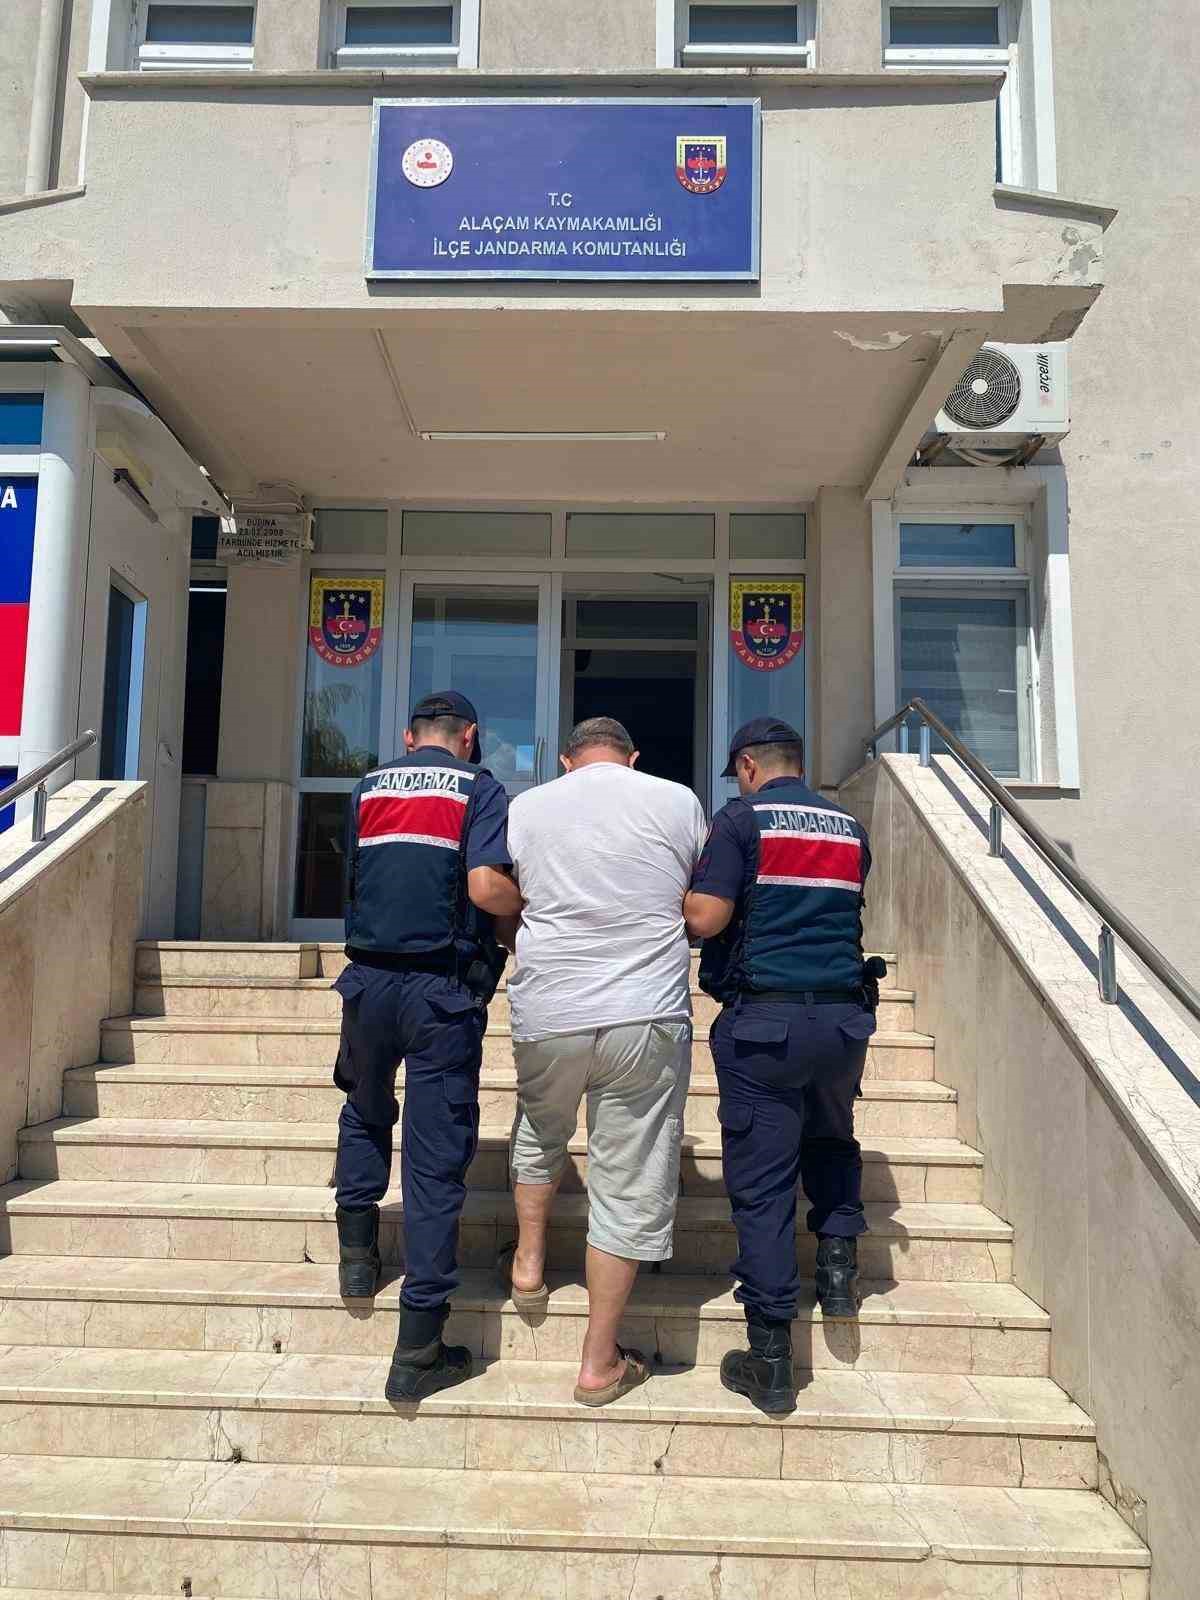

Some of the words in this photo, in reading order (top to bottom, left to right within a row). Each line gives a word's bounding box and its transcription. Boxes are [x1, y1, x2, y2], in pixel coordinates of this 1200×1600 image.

[548, 192, 573, 207] T.C
[459, 216, 529, 233] ALAÇAM
[534, 212, 662, 232] KAYMAKAMLIĞI
[433, 238, 470, 258] İLÇE
[475, 241, 568, 256] JANDARMA
[572, 239, 687, 257] KOMUTANLIĞI
[0, 485, 18, 509] A
[372, 772, 459, 792] JANDARMA
[769, 810, 853, 836] JANDARMA
